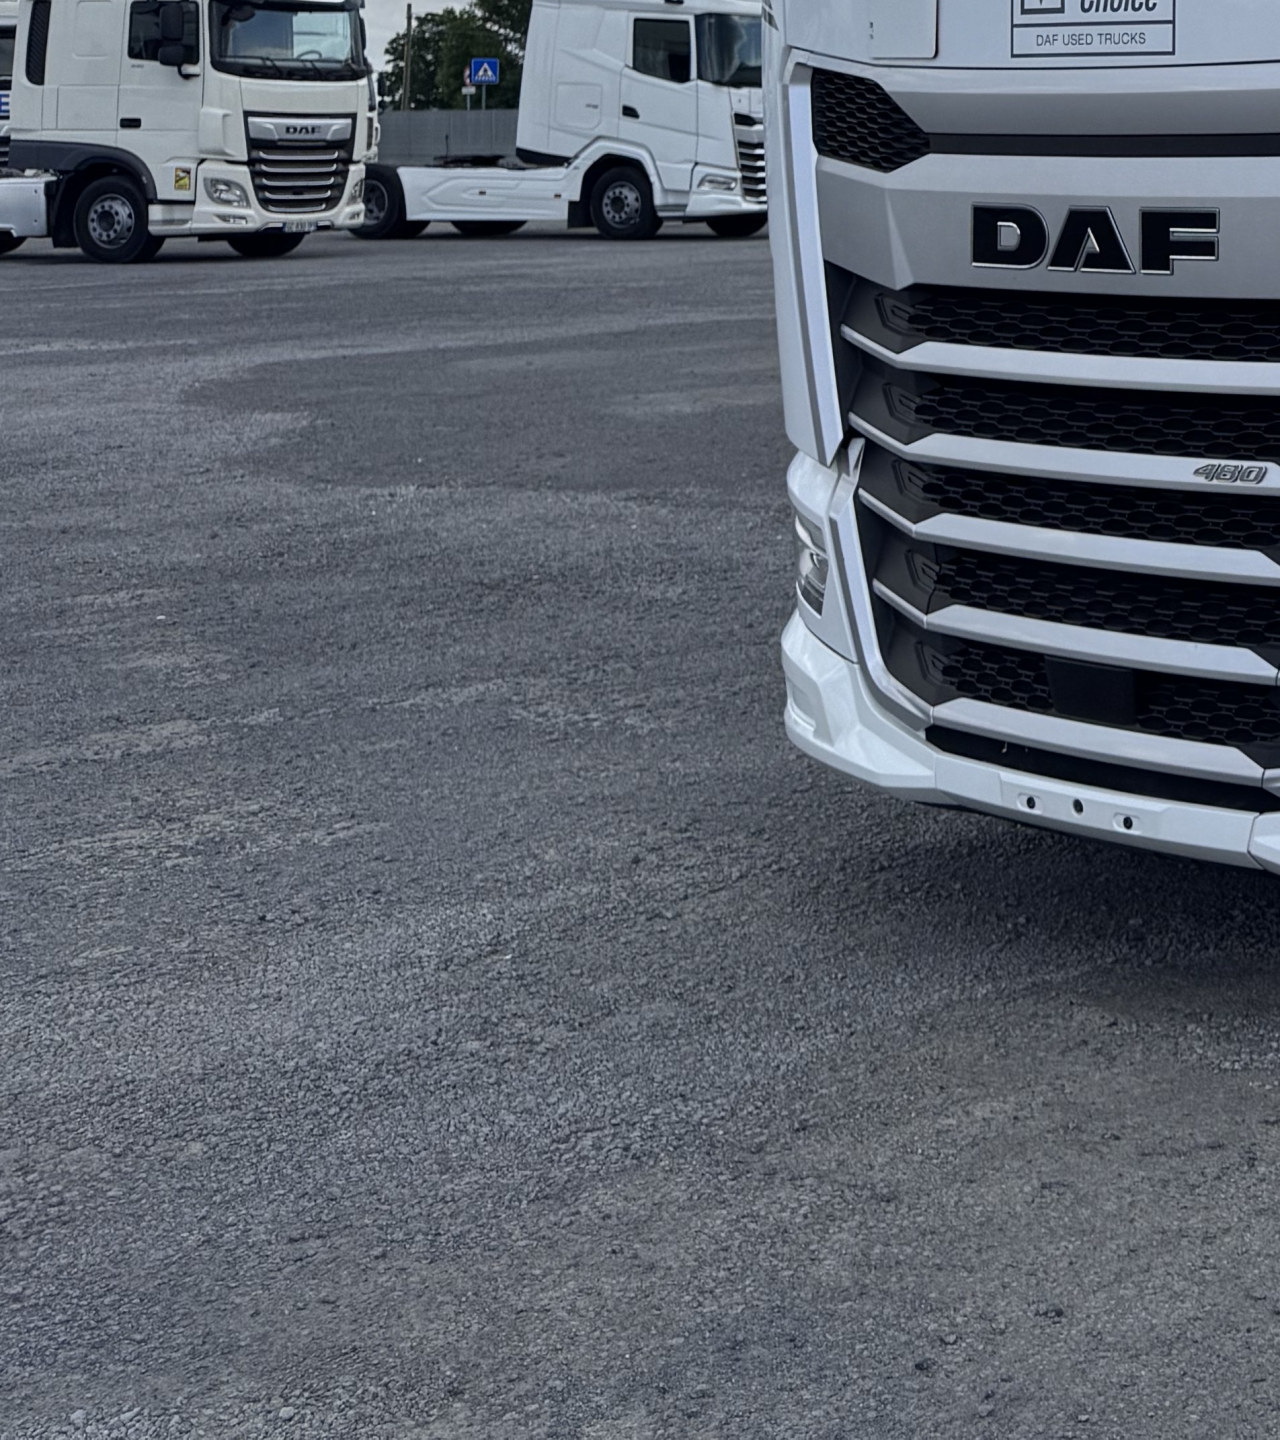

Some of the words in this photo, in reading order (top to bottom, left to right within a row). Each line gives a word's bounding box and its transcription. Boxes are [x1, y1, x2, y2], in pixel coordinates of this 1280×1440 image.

[1036, 34, 1059, 47] DAF
[1062, 33, 1094, 46] USED
[1097, 32, 1146, 45] TRUCKS
[285, 125, 322, 135] DAF
[971, 202, 1220, 275] DAF
[1193, 463, 1268, 485] 480
